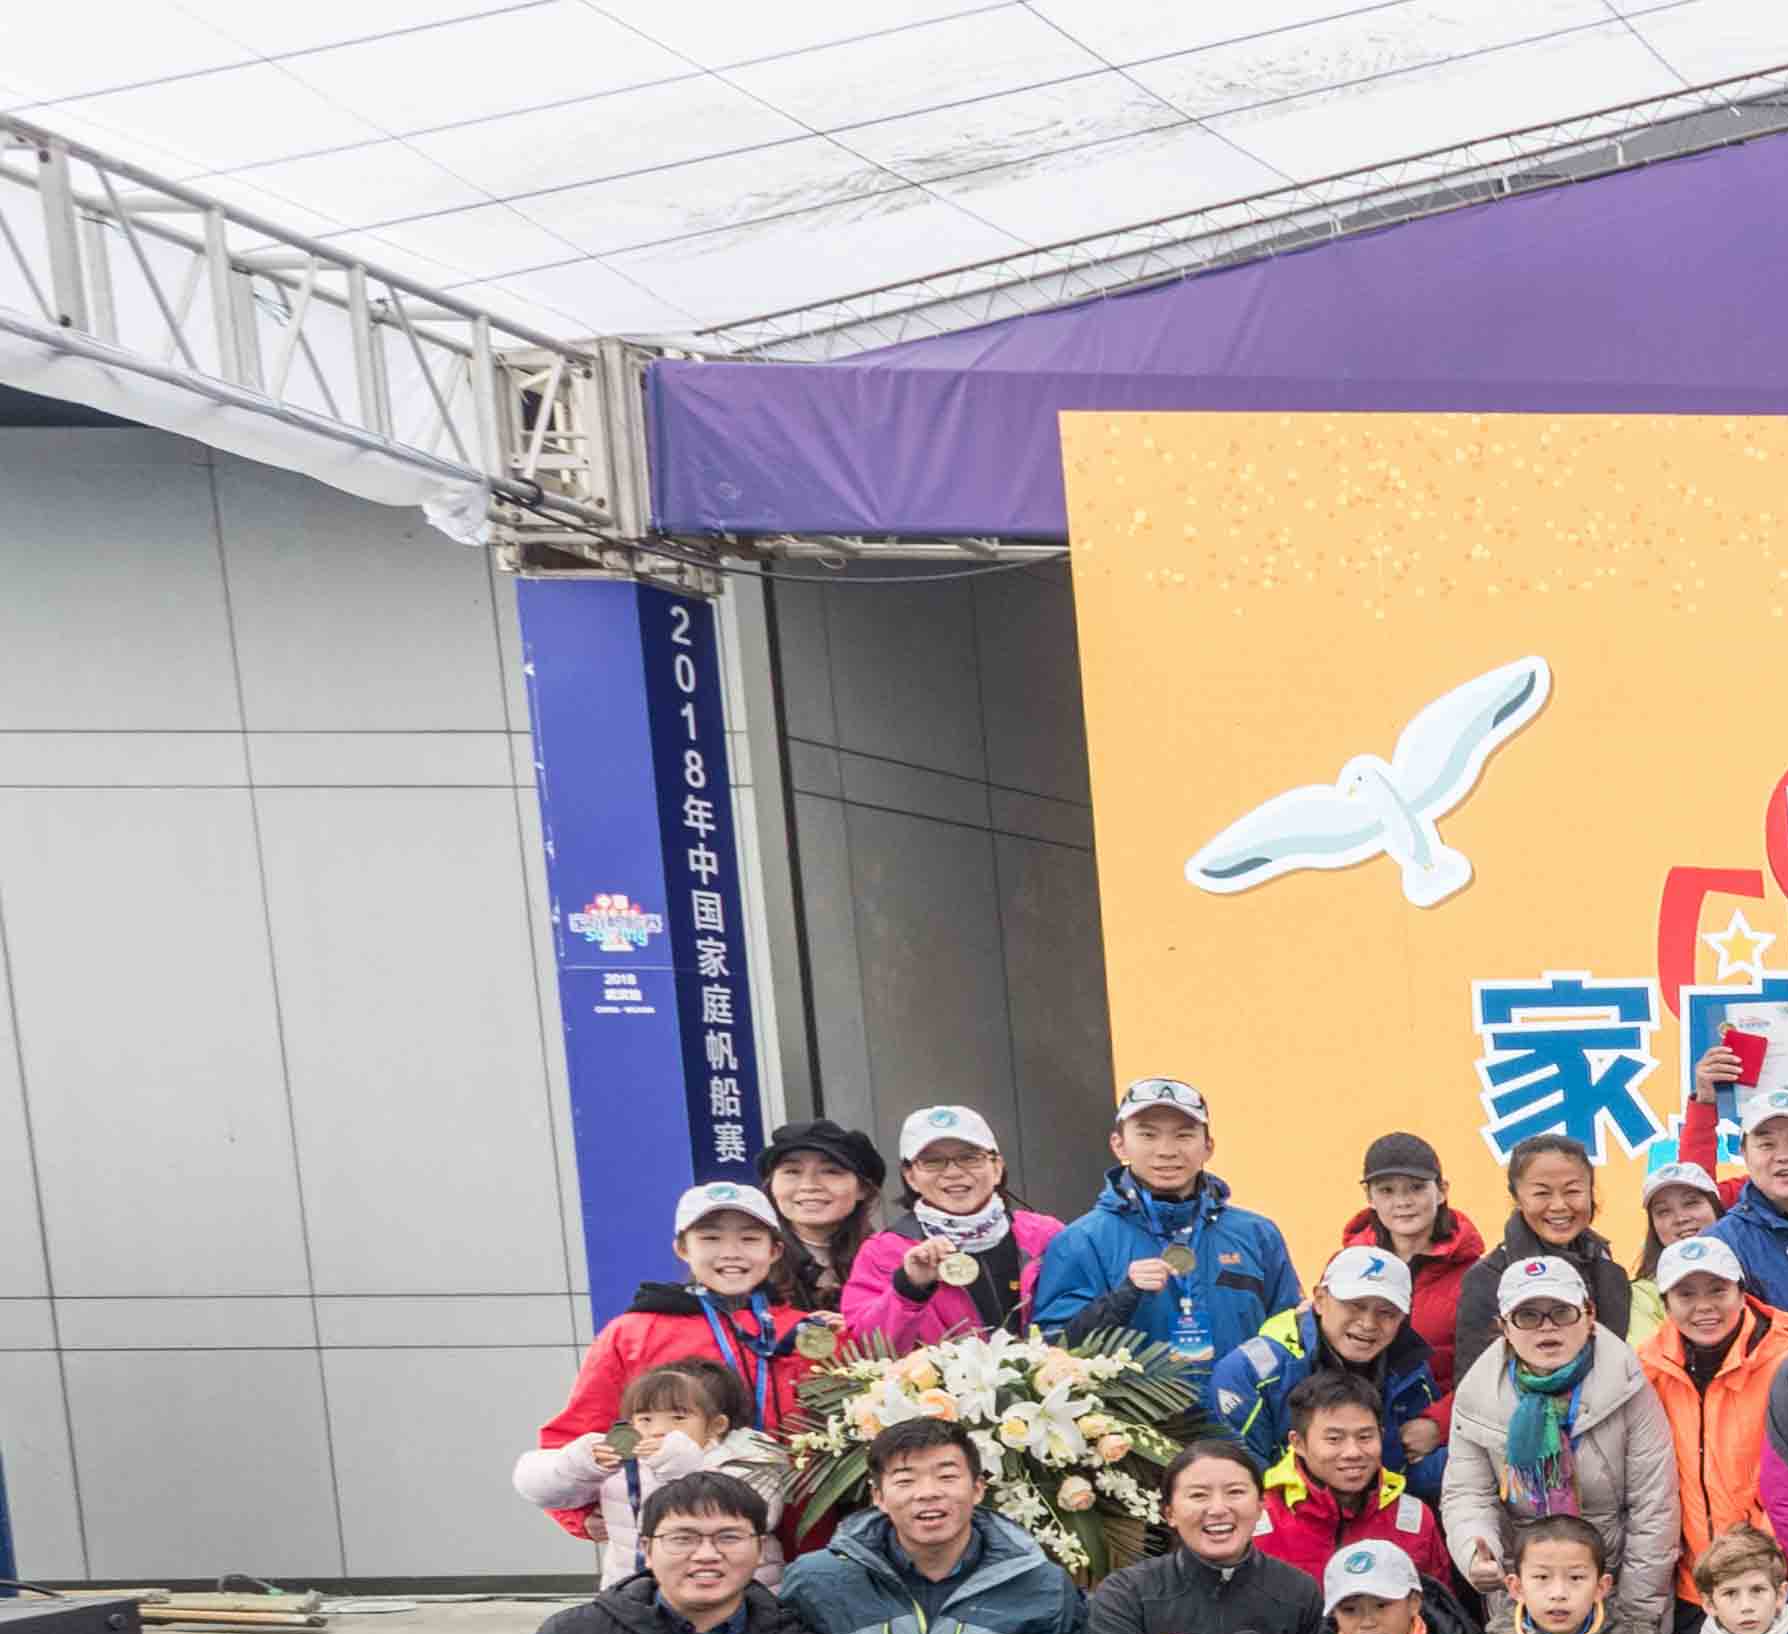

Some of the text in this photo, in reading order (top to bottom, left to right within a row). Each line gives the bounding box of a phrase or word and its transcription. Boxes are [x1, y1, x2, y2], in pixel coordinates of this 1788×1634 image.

[669, 604, 747, 1164] 2018年中国家庭帆船赛
